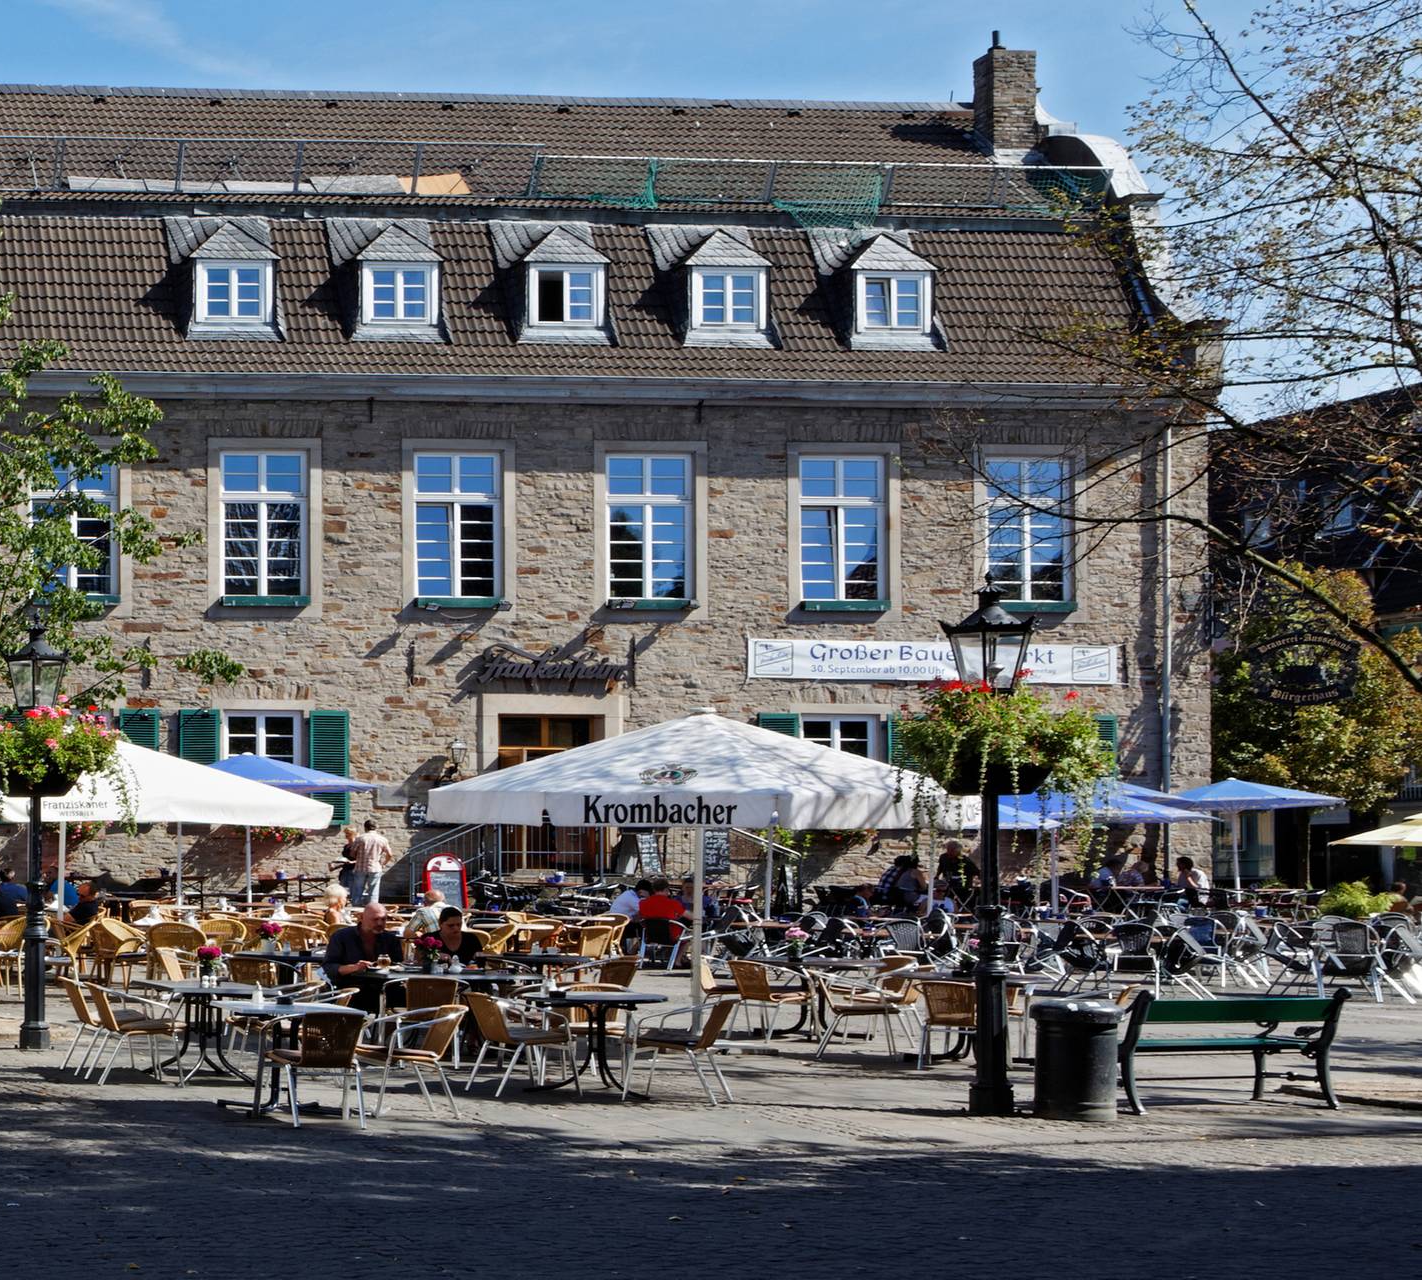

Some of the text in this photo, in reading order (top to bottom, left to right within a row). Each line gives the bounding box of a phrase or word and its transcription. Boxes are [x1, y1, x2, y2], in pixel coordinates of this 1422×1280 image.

[810, 643, 894, 661] Großer
[479, 643, 626, 684] Frankenheim
[811, 664, 945, 675] 30. September ab 10.00 Uhr
[1270, 688, 1339, 704] Bürgerhaus
[42, 800, 108, 810] Franziskaner
[583, 794, 738, 825] Krombacher
